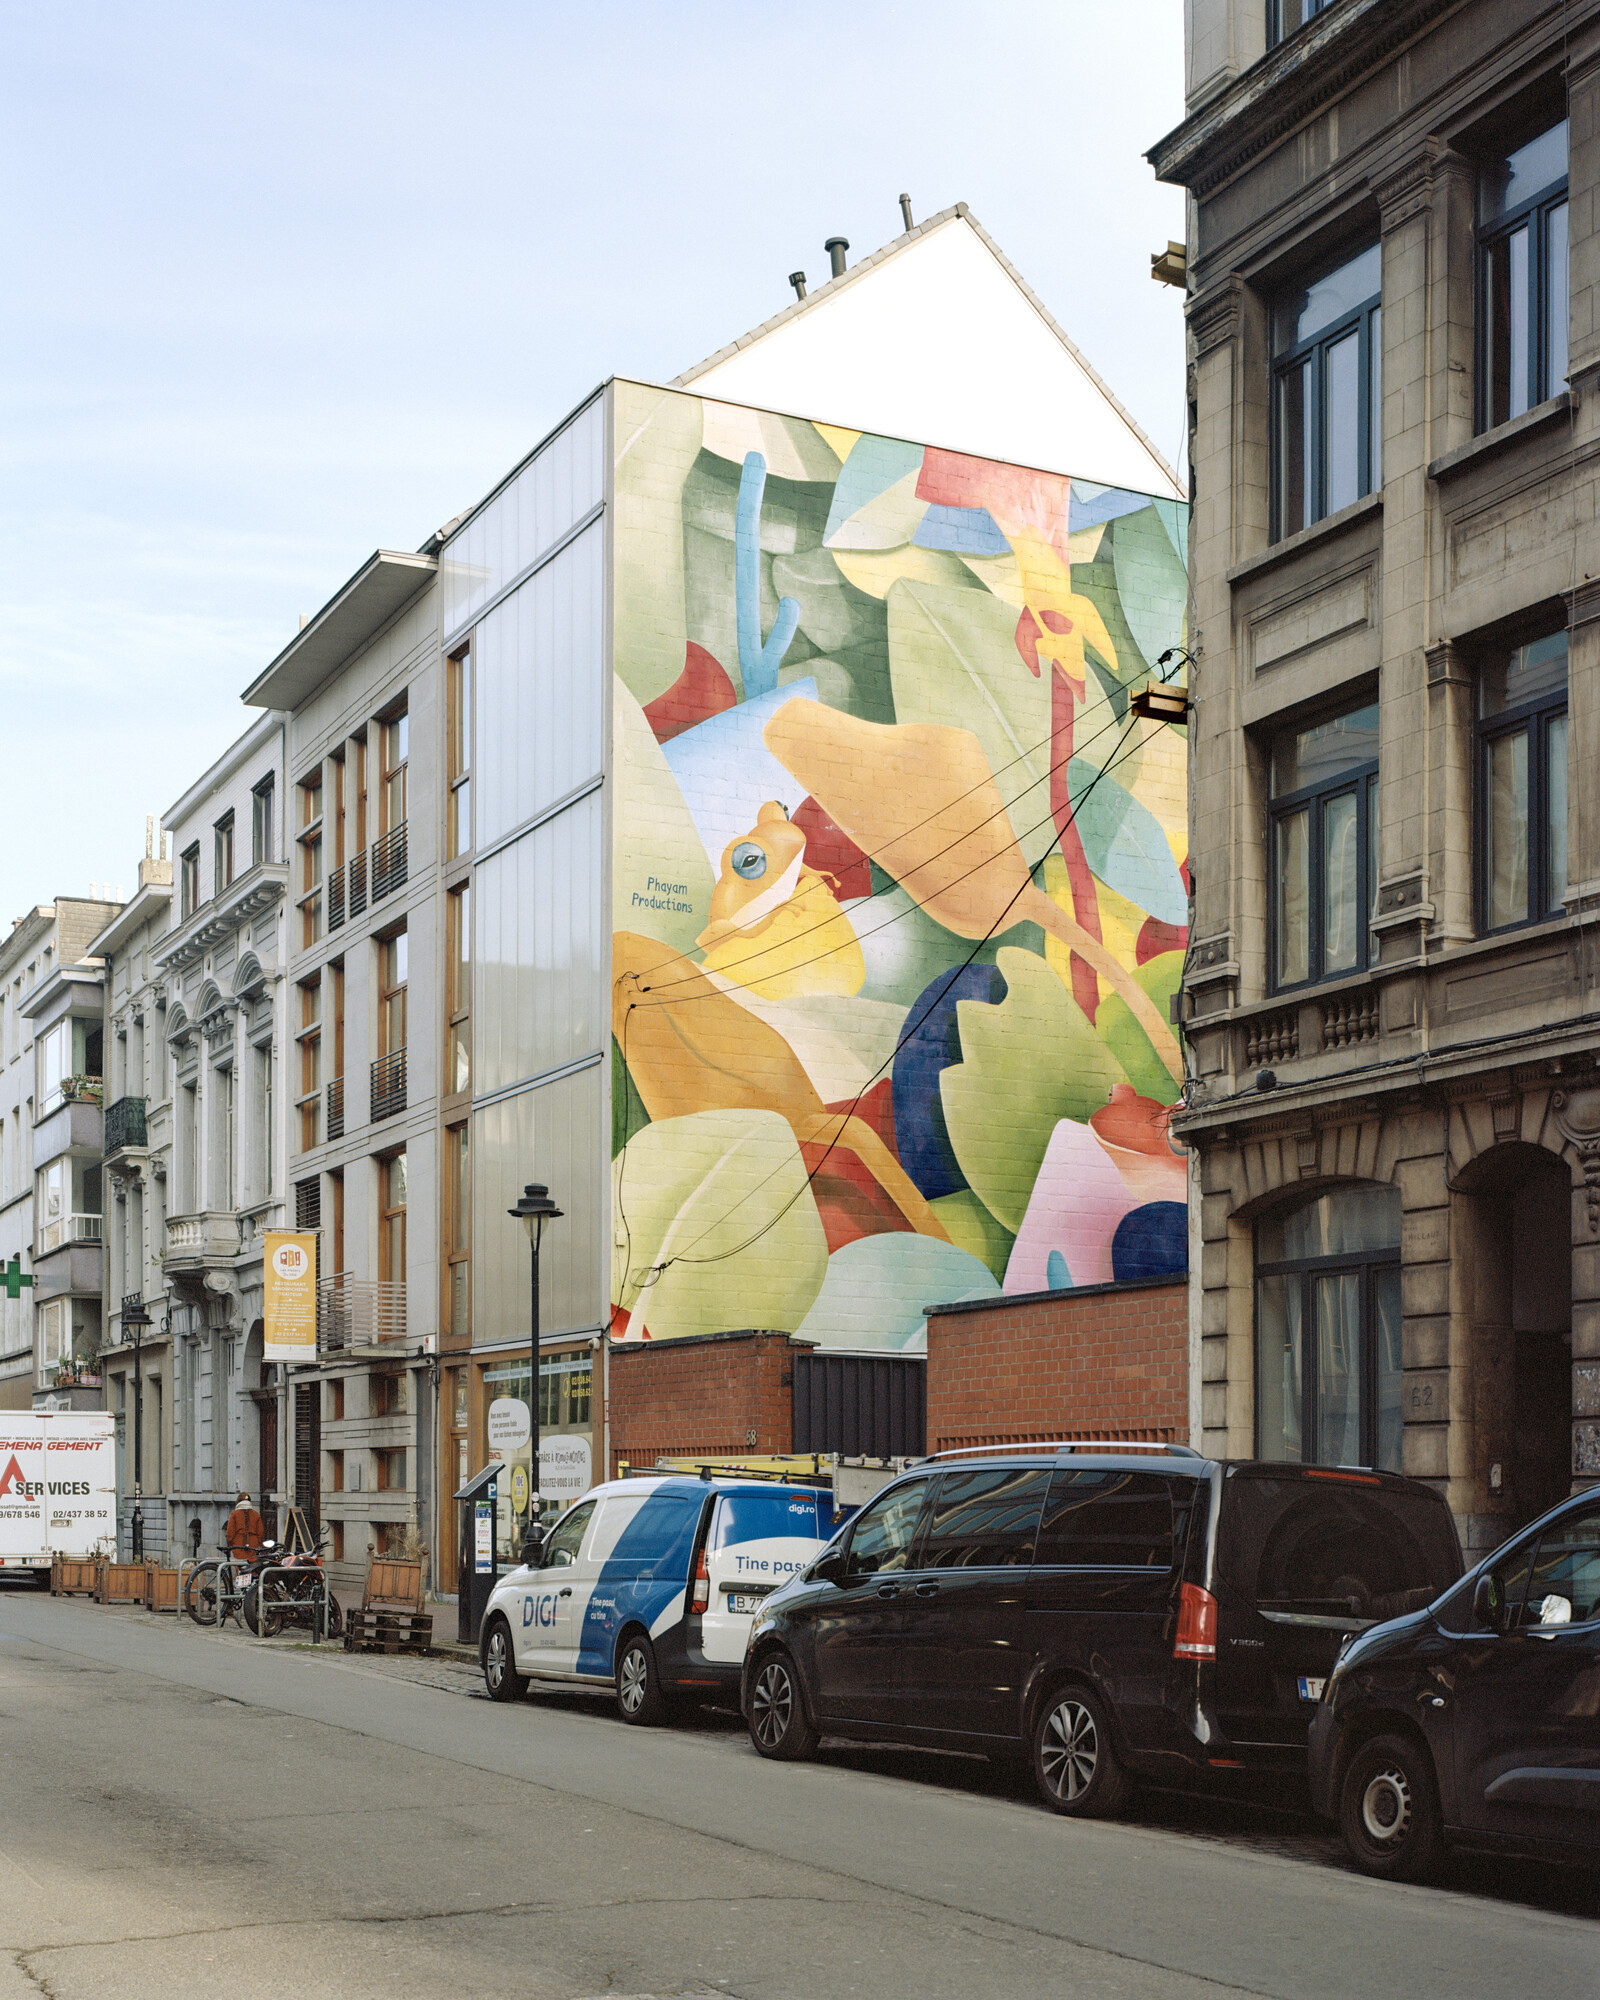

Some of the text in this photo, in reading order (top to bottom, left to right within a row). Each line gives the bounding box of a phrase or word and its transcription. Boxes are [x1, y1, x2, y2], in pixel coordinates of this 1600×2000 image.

[646, 876, 688, 895] Phayam
[632, 892, 692, 913] Productions
[1412, 1385, 1433, 1406] 62
[746, 1429, 757, 1445] 58
[488, 1484, 496, 1495] P
[568, 1478, 573, 1487] LA
[789, 1504, 815, 1514] digi.ro
[736, 1556, 768, 1573] Ține
[737, 1597, 745, 1608] B
[523, 1595, 558, 1627] DIGI
